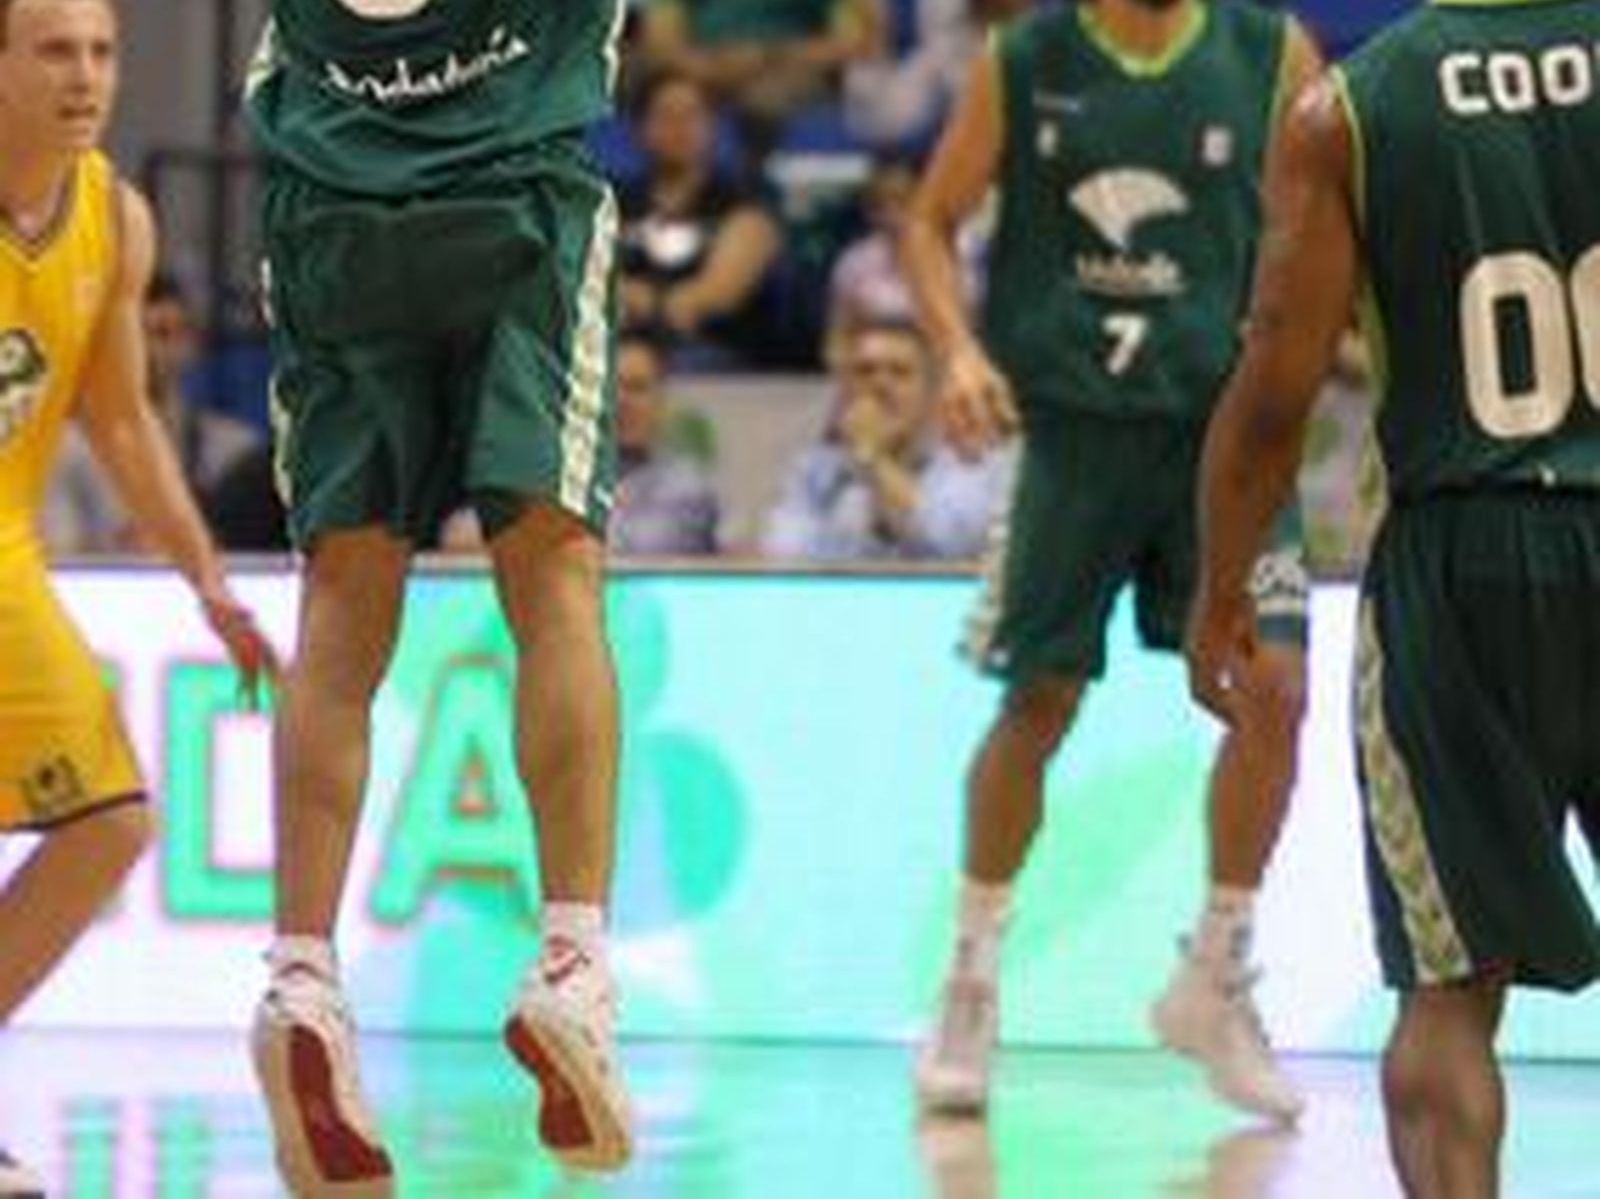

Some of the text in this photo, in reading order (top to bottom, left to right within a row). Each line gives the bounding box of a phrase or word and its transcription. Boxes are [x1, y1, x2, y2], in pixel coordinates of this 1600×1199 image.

[1439, 43, 1600, 116] COO
[1104, 315, 1146, 375] 7
[1459, 244, 1600, 437] 0
